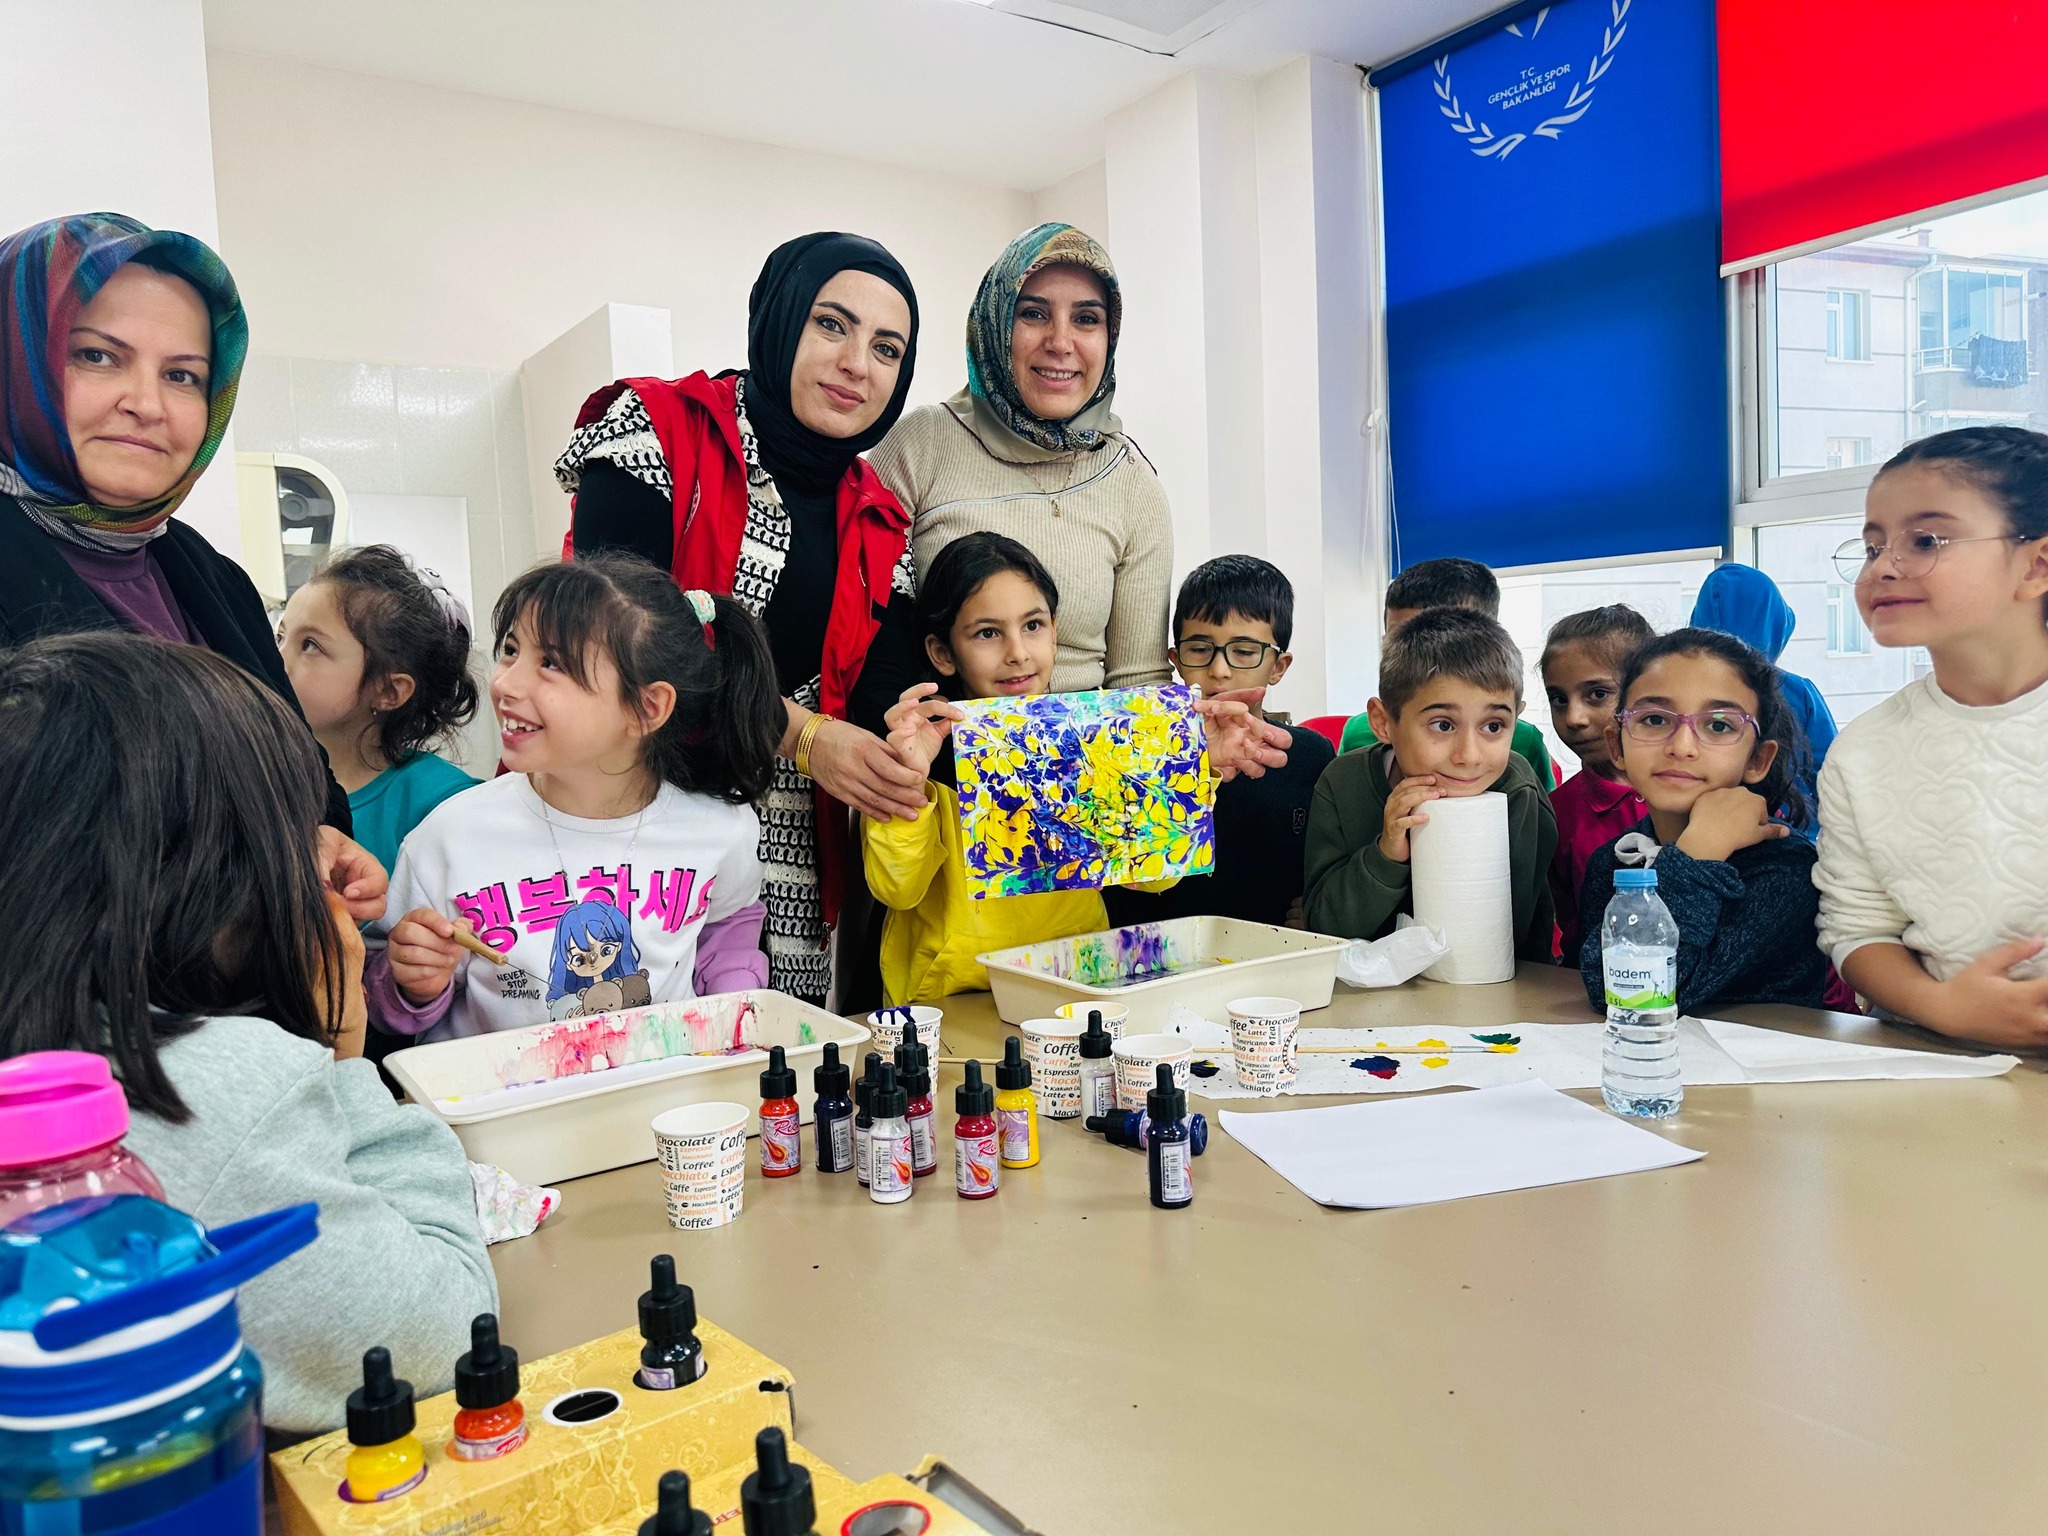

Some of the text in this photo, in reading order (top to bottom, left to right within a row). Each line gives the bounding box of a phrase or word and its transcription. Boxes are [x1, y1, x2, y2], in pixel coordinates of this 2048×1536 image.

[1530, 75, 1542, 86] VE
[1544, 64, 1571, 82] SPOR
[1502, 80, 1556, 110] BAKANLIĞI
[496, 969, 526, 982] NEVER
[1609, 966, 1651, 979] badem
[507, 978, 528, 989] STOP
[500, 989, 541, 1000] DREAMING
[1236, 1038, 1268, 1046] Americano
[1044, 1058, 1068, 1066] Caffe
[1256, 1072, 1275, 1080] Caffe
[1127, 1079, 1152, 1088] Coffee
[657, 1136, 716, 1147] Chocolate
[680, 1145, 713, 1153] Espresso
[666, 1146, 674, 1163] Tea
[683, 1161, 714, 1171] Coffee
[669, 1182, 690, 1192] Caffe
[694, 1185, 717, 1193] Espresso
[673, 1192, 717, 1200] Americano
[680, 1217, 713, 1228] Coffee
